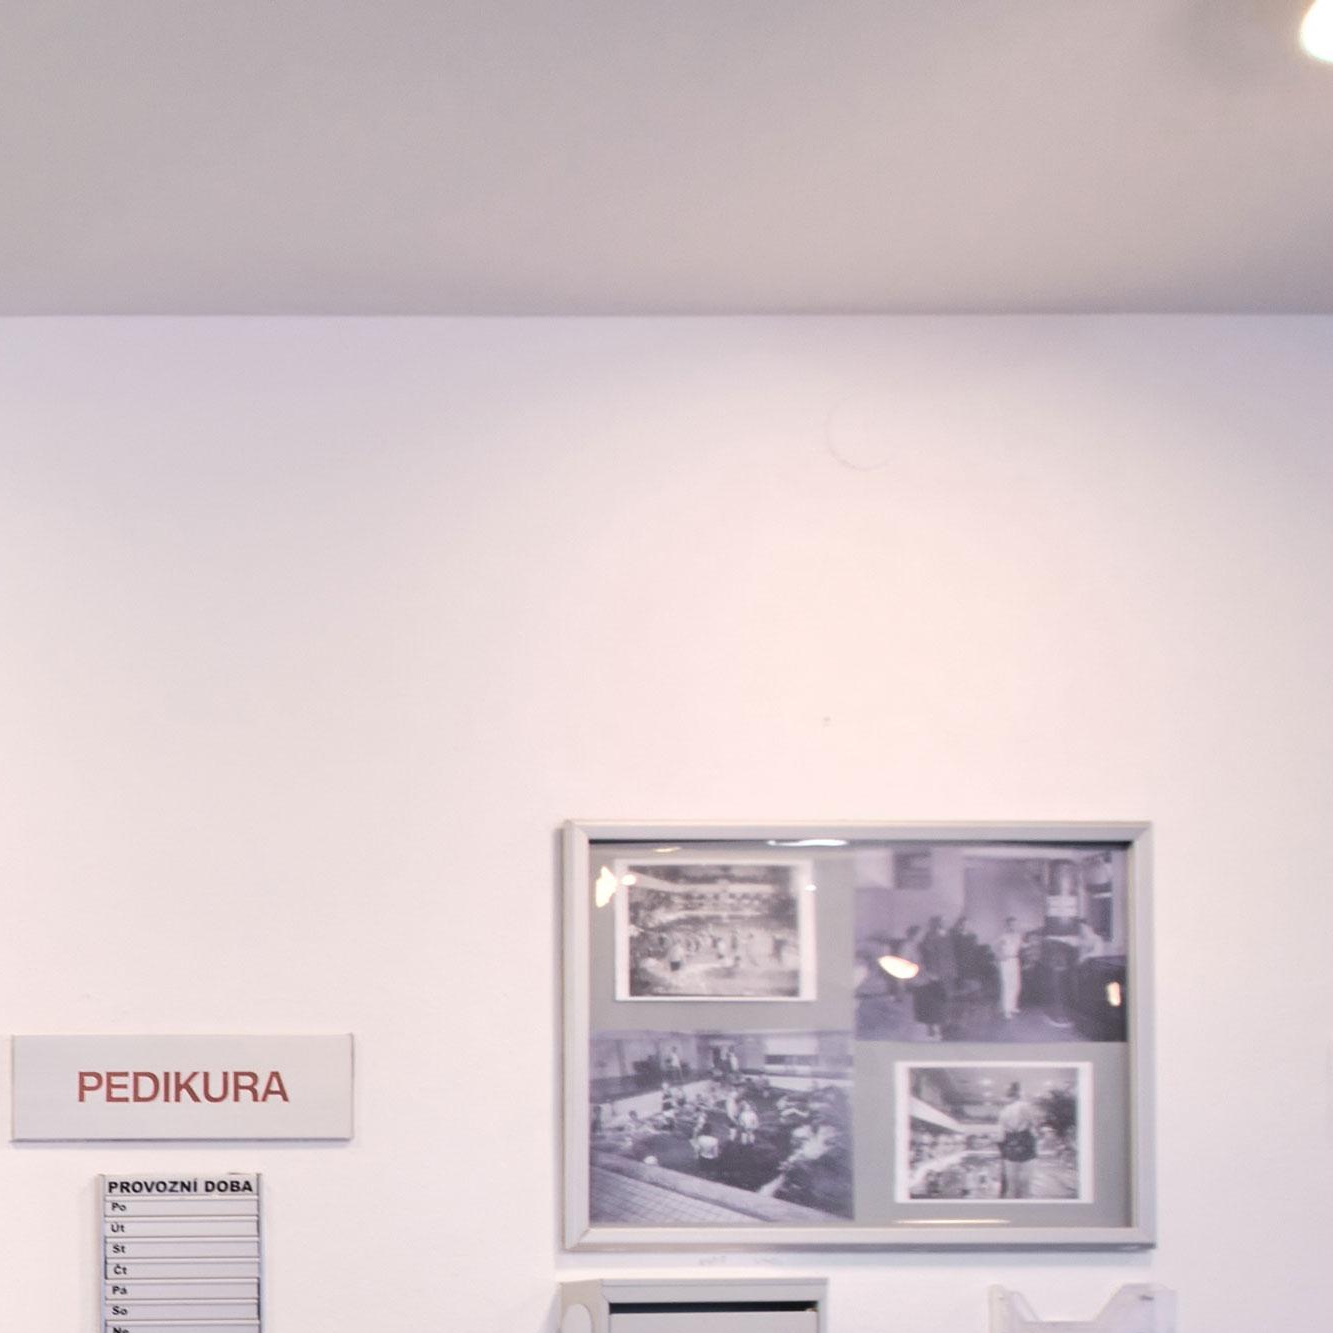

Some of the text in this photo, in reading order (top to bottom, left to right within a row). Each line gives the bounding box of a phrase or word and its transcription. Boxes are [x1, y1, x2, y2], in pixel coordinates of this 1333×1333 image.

[77, 1070, 291, 1103] PEDIKURA
[108, 1178, 254, 1194] PROVOZNÍ DOBA
[111, 1201, 128, 1212] Po
[112, 1244, 127, 1254] St
[111, 1305, 129, 1316] So
